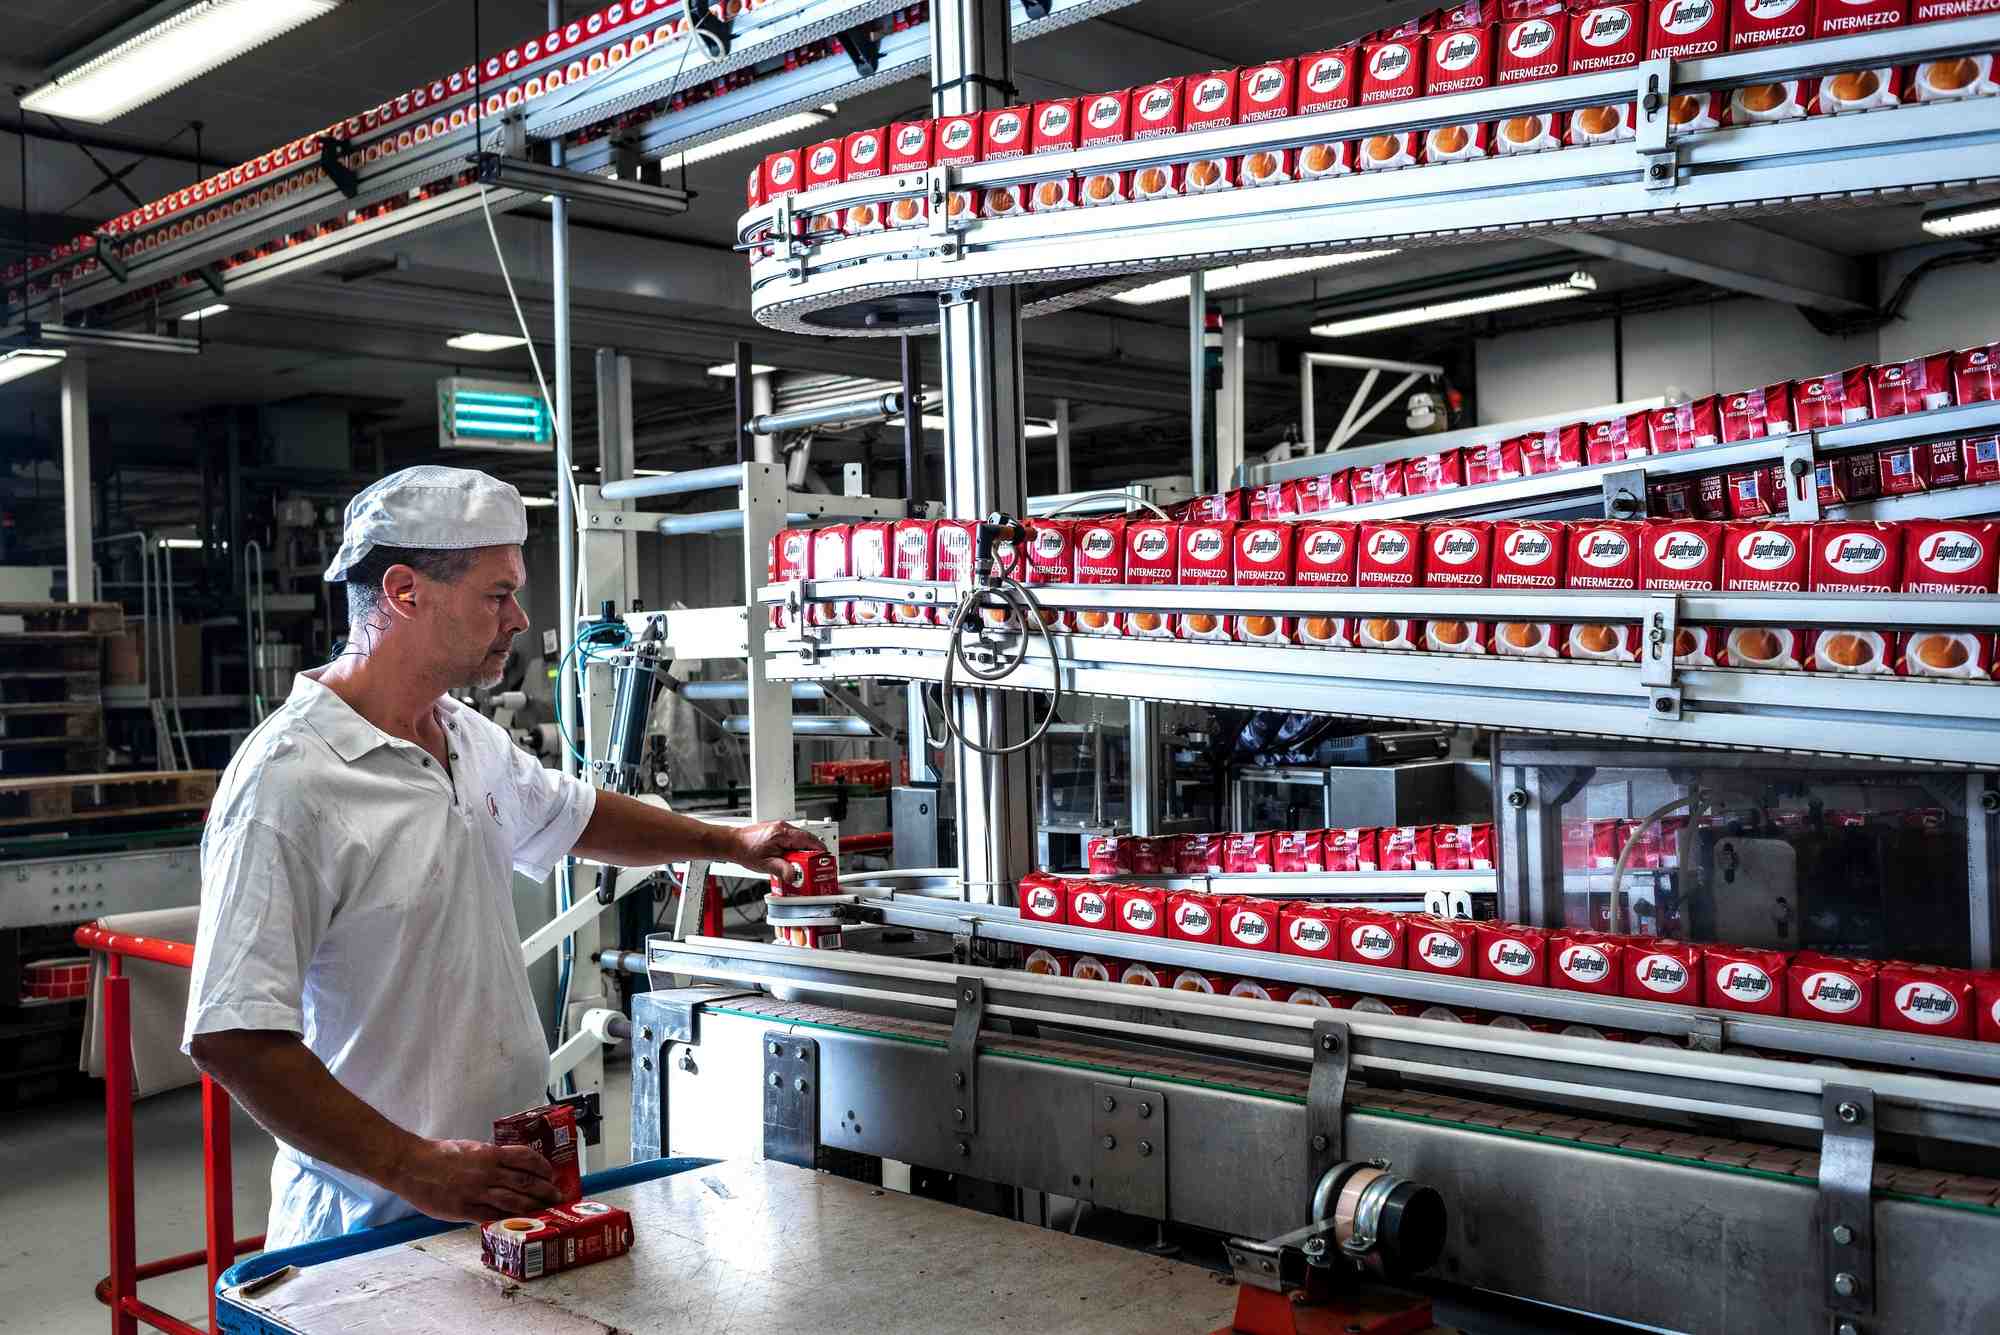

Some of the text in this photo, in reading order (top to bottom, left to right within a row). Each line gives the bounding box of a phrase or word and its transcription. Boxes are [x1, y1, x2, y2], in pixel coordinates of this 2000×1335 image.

[1664, 2, 1710, 27] Segafredo
[1824, 10, 1900, 32] INTERMEZZO
[1585, 15, 1628, 40] Segafredo
[1735, 25, 1805, 44] INTERMEZZO
[1512, 27, 1552, 51] Segafredo
[1440, 40, 1477, 63] Segafredo
[1651, 40, 1718, 59] INTERMEZZO
[1373, 51, 1408, 73] Segafredo
[1573, 52, 1635, 71] INTERMEZZO
[1310, 64, 1343, 86] Segafredo
[1500, 64, 1558, 81] INTERMEZZO
[1252, 74, 1282, 95] Segafredo
[1362, 86, 1414, 102] INTERMEZZO
[1428, 76, 1483, 93] INTERMEZZO
[1197, 85, 1226, 106] Segafredo
[1242, 108, 1287, 122] INTERMEZZO
[1300, 98, 1348, 114] INTERMEZZO
[1187, 118, 1231, 131] INTERMEZZO
[1247, 535, 1278, 554] Segafredo
[1308, 536, 1342, 555] Segafredo
[1372, 536, 1406, 555] Segafredo
[1438, 534, 1476, 555] Segafredo
[1509, 535, 1548, 556] Segafredo
[1584, 536, 1624, 558] Segafredo
[1660, 537, 1704, 560] Segafredo
[1744, 536, 1791, 560] Segafredo
[1831, 539, 1880, 563] Segafredo
[1924, 537, 1978, 562] Segafredo
[1182, 568, 1227, 578] INTERMEZZO
[1238, 570, 1285, 580] INTERMEZZO
[1298, 572, 1348, 582] INTERMEZZO
[1360, 572, 1412, 584] INTERMEZZO
[1428, 572, 1482, 584] INTERMEZZO
[1497, 574, 1556, 586] INTERMEZZO
[1570, 576, 1634, 588] INTERMEZZO
[1646, 578, 1712, 590] INTERMEZZO
[1729, 580, 1800, 592] INTERMEZZO
[1179, 908, 1208, 926] Segafredo
[1235, 916, 1265, 936] Segafredo
[1294, 922, 1327, 941] Segafredo
[1356, 930, 1391, 950] Segafredo
[1424, 938, 1459, 957] Segafredo
[1494, 944, 1530, 964] Segafredo
[1565, 950, 1606, 972] Segafredo
[1642, 960, 1683, 982] Segafredo
[1723, 968, 1767, 990] Segafredo
[1808, 978, 1856, 1000] Segafredo
[1901, 988, 1952, 1012] Segafredo
